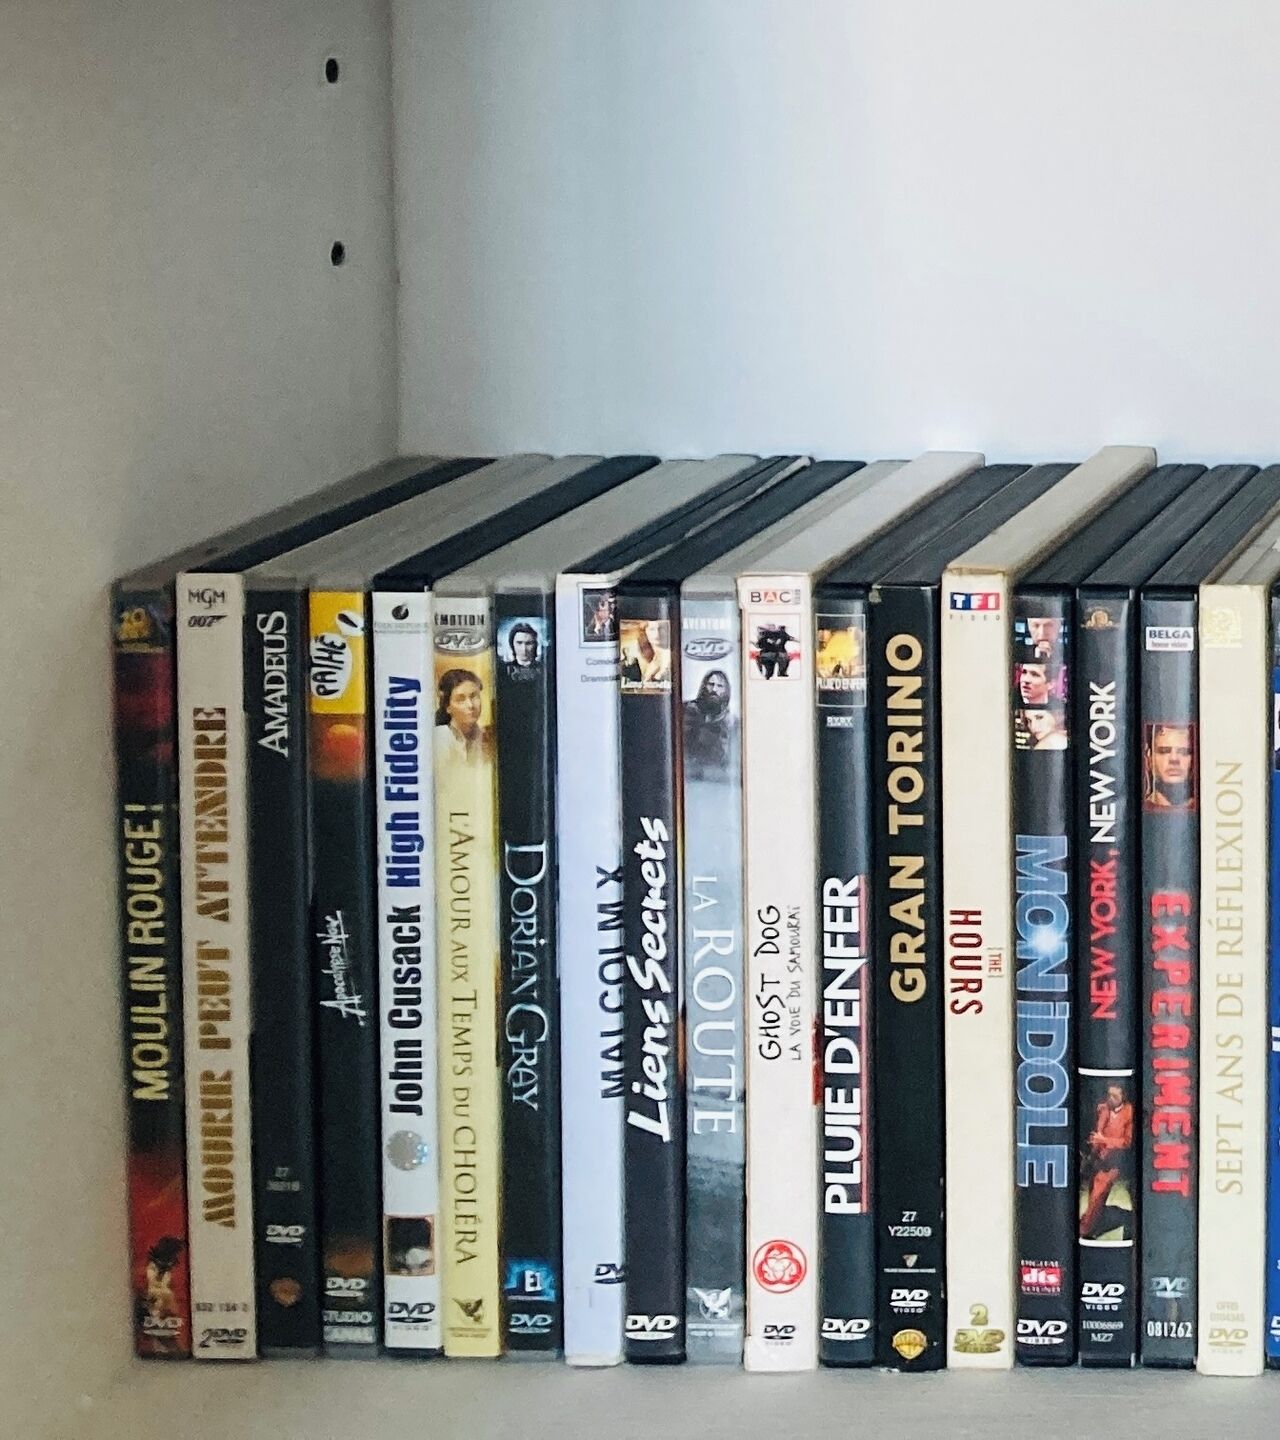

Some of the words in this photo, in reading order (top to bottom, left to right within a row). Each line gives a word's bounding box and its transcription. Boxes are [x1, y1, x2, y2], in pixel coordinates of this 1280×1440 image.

[187, 615, 228, 629] 007
[188, 588, 226, 609] MGM
[750, 591, 792, 603] BAC
[951, 593, 999, 610] TF1
[1148, 629, 1192, 639] BELGA
[256, 610, 290, 759] AMADEUS
[1087, 681, 1117, 762] YORK
[383, 676, 422, 802] Fidelity
[884, 633, 926, 836] TORINO
[193, 707, 230, 923] ATTENDRE
[1089, 765, 1117, 844] NEW
[383, 811, 425, 889] High
[448, 811, 476, 932] L'AMOUR
[594, 864, 625, 890] X
[1089, 848, 1122, 932] YORK,
[1206, 760, 1244, 959] RÉFLEXION
[504, 840, 548, 997] DORIAN
[627, 816, 674, 995] Secrets
[692, 876, 719, 912] LA
[753, 904, 782, 958] DOG
[889, 854, 928, 1004] GRAN
[1015, 835, 1070, 992] MON
[195, 939, 232, 1050] PEUT
[387, 903, 424, 1031] Cusack
[449, 937, 470, 983] AUX
[822, 874, 863, 1075] D'ENFER
[948, 908, 984, 1016] HOURS
[988, 949, 1003, 977] THE
[1089, 943, 1120, 1021] NEW
[1215, 972, 1244, 1022] DE
[130, 956, 170, 1101] MOULIN
[450, 989, 478, 1076] TEMPS
[692, 927, 737, 1136] ROUTE
[758, 973, 785, 1061] GHOST
[788, 1005, 804, 1039] VOIE
[1150, 893, 1192, 1198] EXPERIMENT
[388, 1039, 424, 1118] John
[505, 1003, 549, 1112] GRAY
[626, 998, 671, 1143] Liens
[1215, 1033, 1244, 1104] ANS
[451, 1086, 470, 1118] DU
[199, 1069, 238, 1229] MOURIR
[823, 1087, 863, 1215] PLUIE
[1214, 1114, 1244, 1196] SEPT
[452, 1124, 480, 1265] CHOLÉRA
[888, 1226, 932, 1238] Y22509
[901, 1211, 917, 1223] Z7
[968, 1303, 989, 1327] 2
[1021, 1267, 1060, 1286] dts
[1081, 1282, 1126, 1297] DVD
[626, 1315, 680, 1330] DVD
[822, 1317, 872, 1333] DVD
[1016, 1319, 1069, 1336] DVD
[1146, 1320, 1193, 1338] 081262
